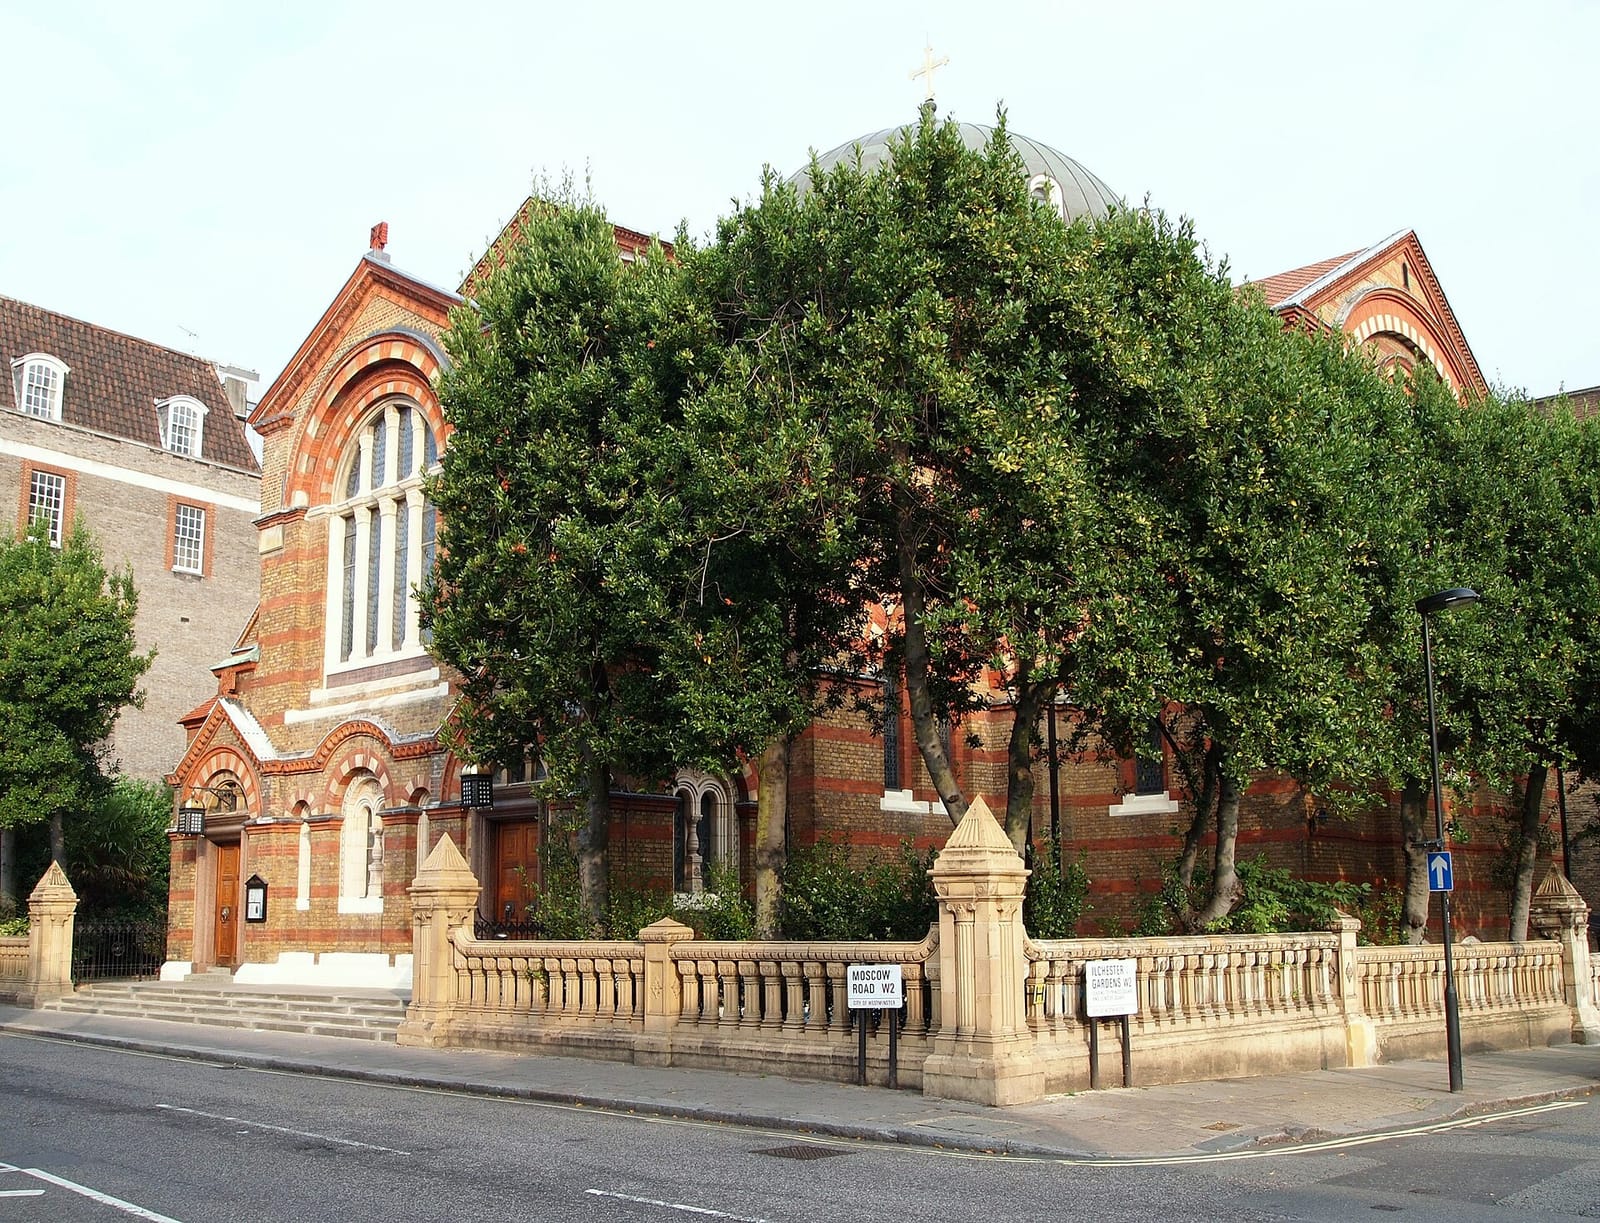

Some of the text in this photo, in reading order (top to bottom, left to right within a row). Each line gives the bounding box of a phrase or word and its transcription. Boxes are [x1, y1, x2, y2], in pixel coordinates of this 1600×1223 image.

[852, 970, 890, 981] MOSCOW
[1091, 965, 1124, 976] ILCHESTER
[852, 983, 895, 994] ROAD W2
[1092, 977, 1132, 989] GARDENS W2
